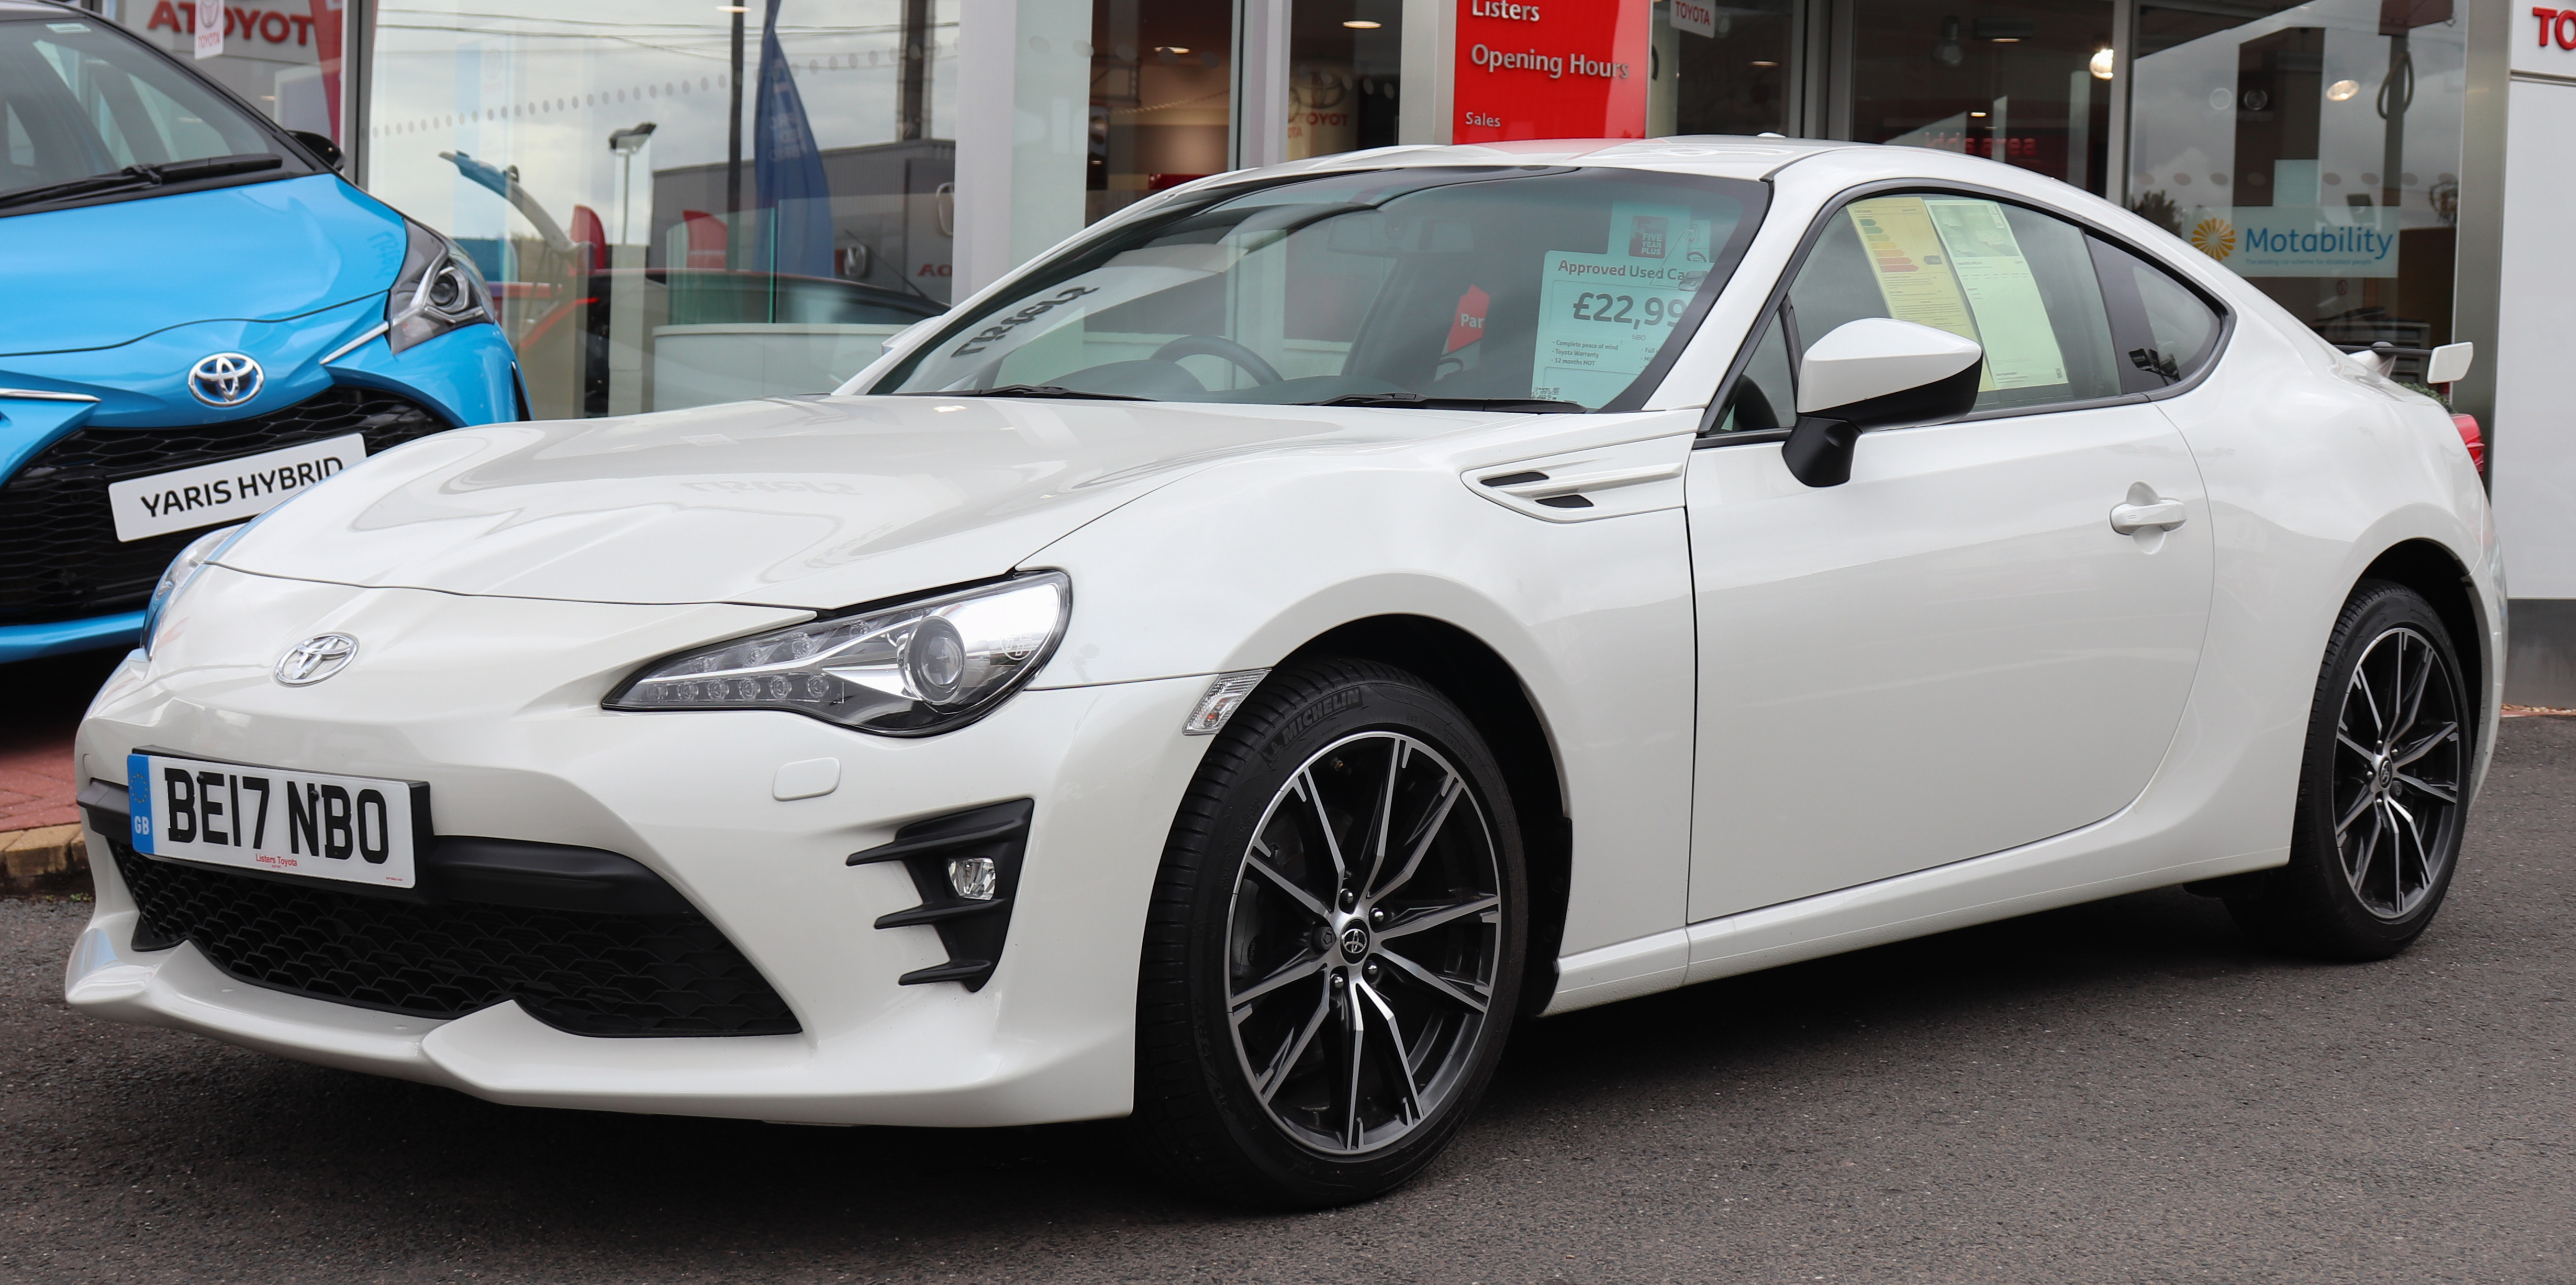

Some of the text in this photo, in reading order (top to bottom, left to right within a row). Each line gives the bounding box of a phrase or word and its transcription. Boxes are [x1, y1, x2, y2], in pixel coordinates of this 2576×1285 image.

[1472, 0, 1540, 21] Listers
[1676, 1, 1710, 25] TOYOTA
[1471, 43, 1630, 79] Opening Hours
[1466, 112, 1501, 127] Sales
[1643, 233, 1663, 242] FIVE
[2246, 226, 2393, 260] Motability
[1558, 260, 1626, 276] Approved
[1629, 265, 1664, 279] Used
[1574, 350, 1599, 359] Warranty
[140, 457, 343, 517] YARIS HYBRID
[1282, 689, 1359, 745] MICHELIN
[134, 815, 150, 835] GB
[164, 767, 389, 865] BE17 NBO
[255, 853, 298, 867] Listers Toyota
